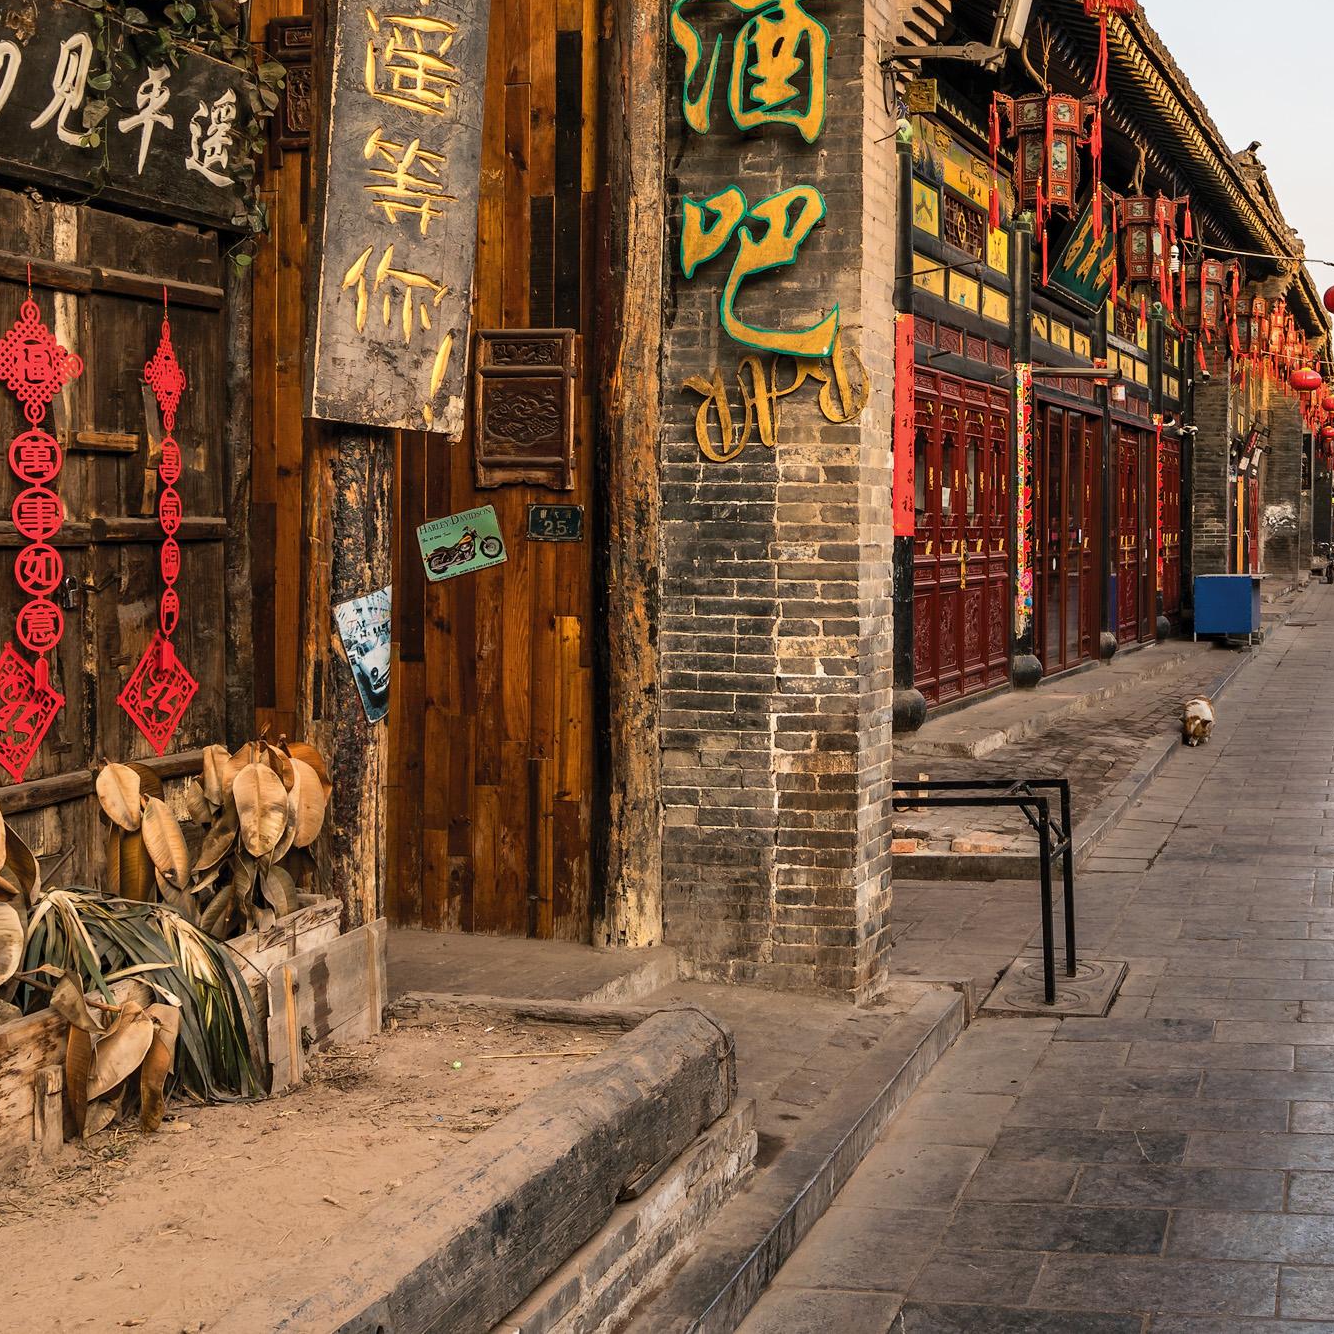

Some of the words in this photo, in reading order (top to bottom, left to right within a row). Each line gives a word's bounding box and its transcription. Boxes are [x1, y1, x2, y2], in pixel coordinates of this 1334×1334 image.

[13, 435, 60, 646] 萬事如意
[544, 520, 567, 535] 25
